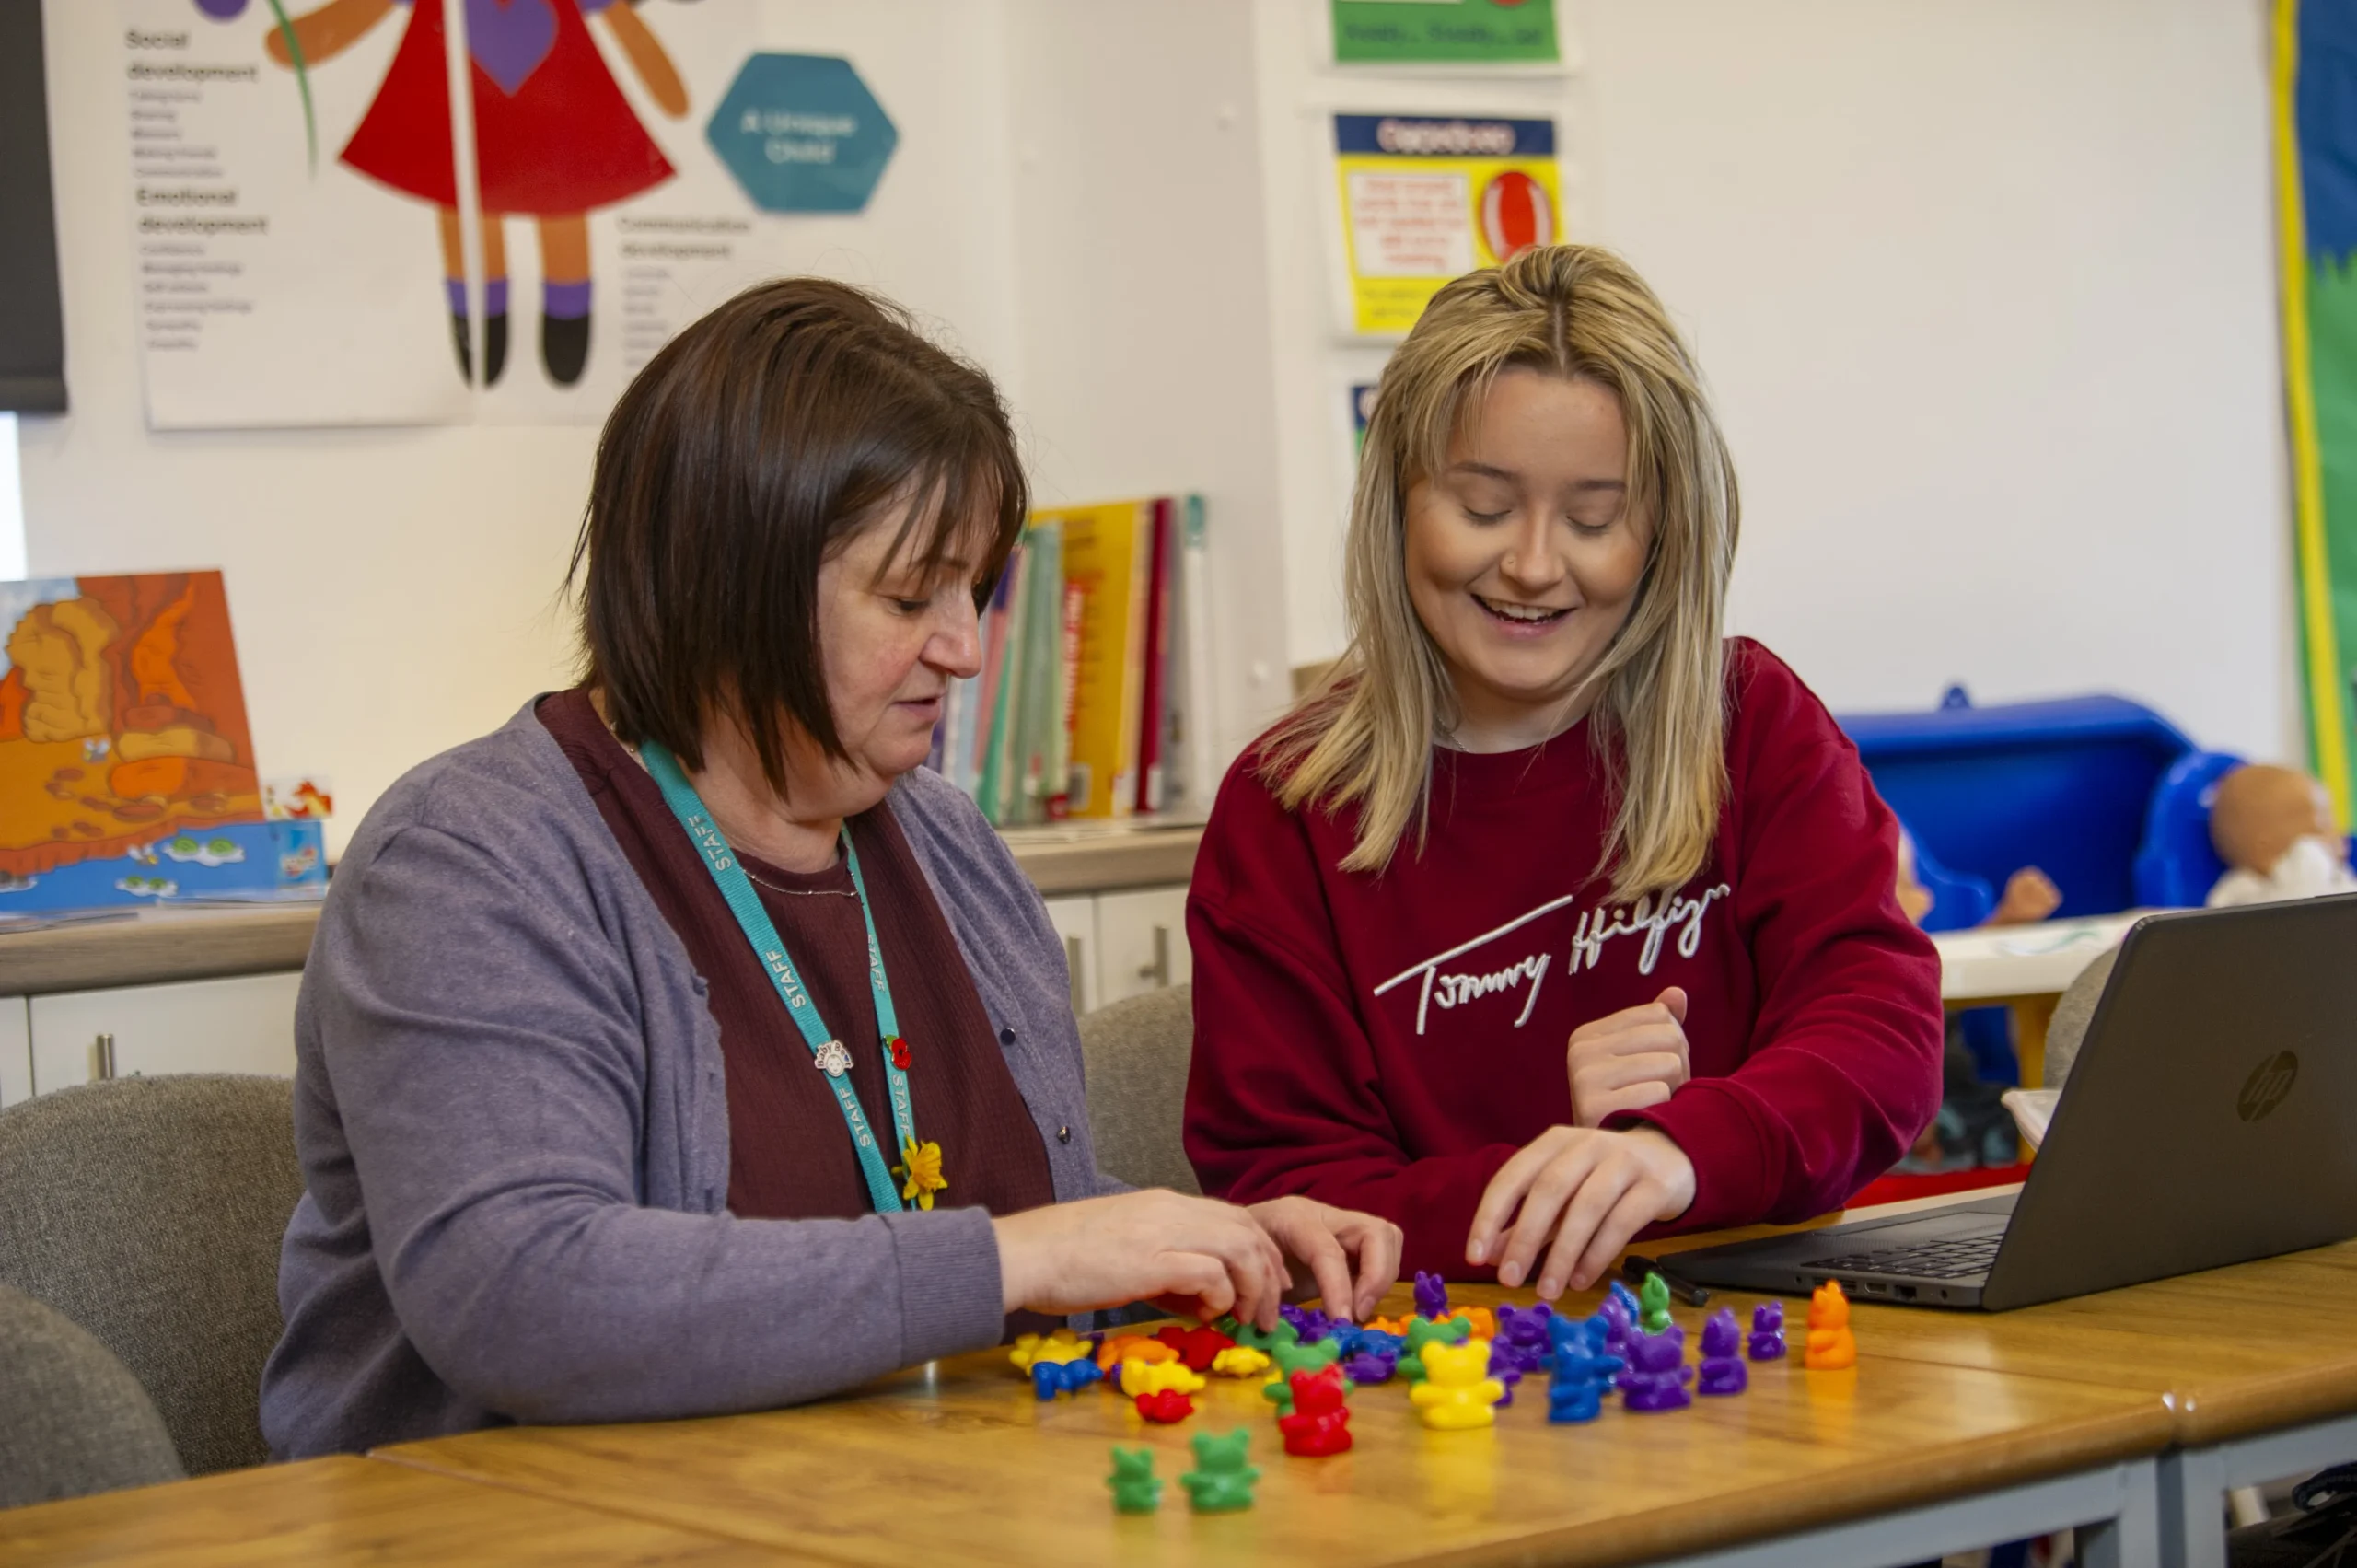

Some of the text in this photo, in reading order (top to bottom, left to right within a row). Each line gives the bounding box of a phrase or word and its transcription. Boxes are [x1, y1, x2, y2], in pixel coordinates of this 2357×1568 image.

[688, 815, 731, 871] STAFF
[765, 949, 807, 1009] STAFF
[1373, 893, 1574, 1036] Tommy
[839, 1087, 871, 1148] STAFF
[892, 1074, 911, 1136] STAFF
